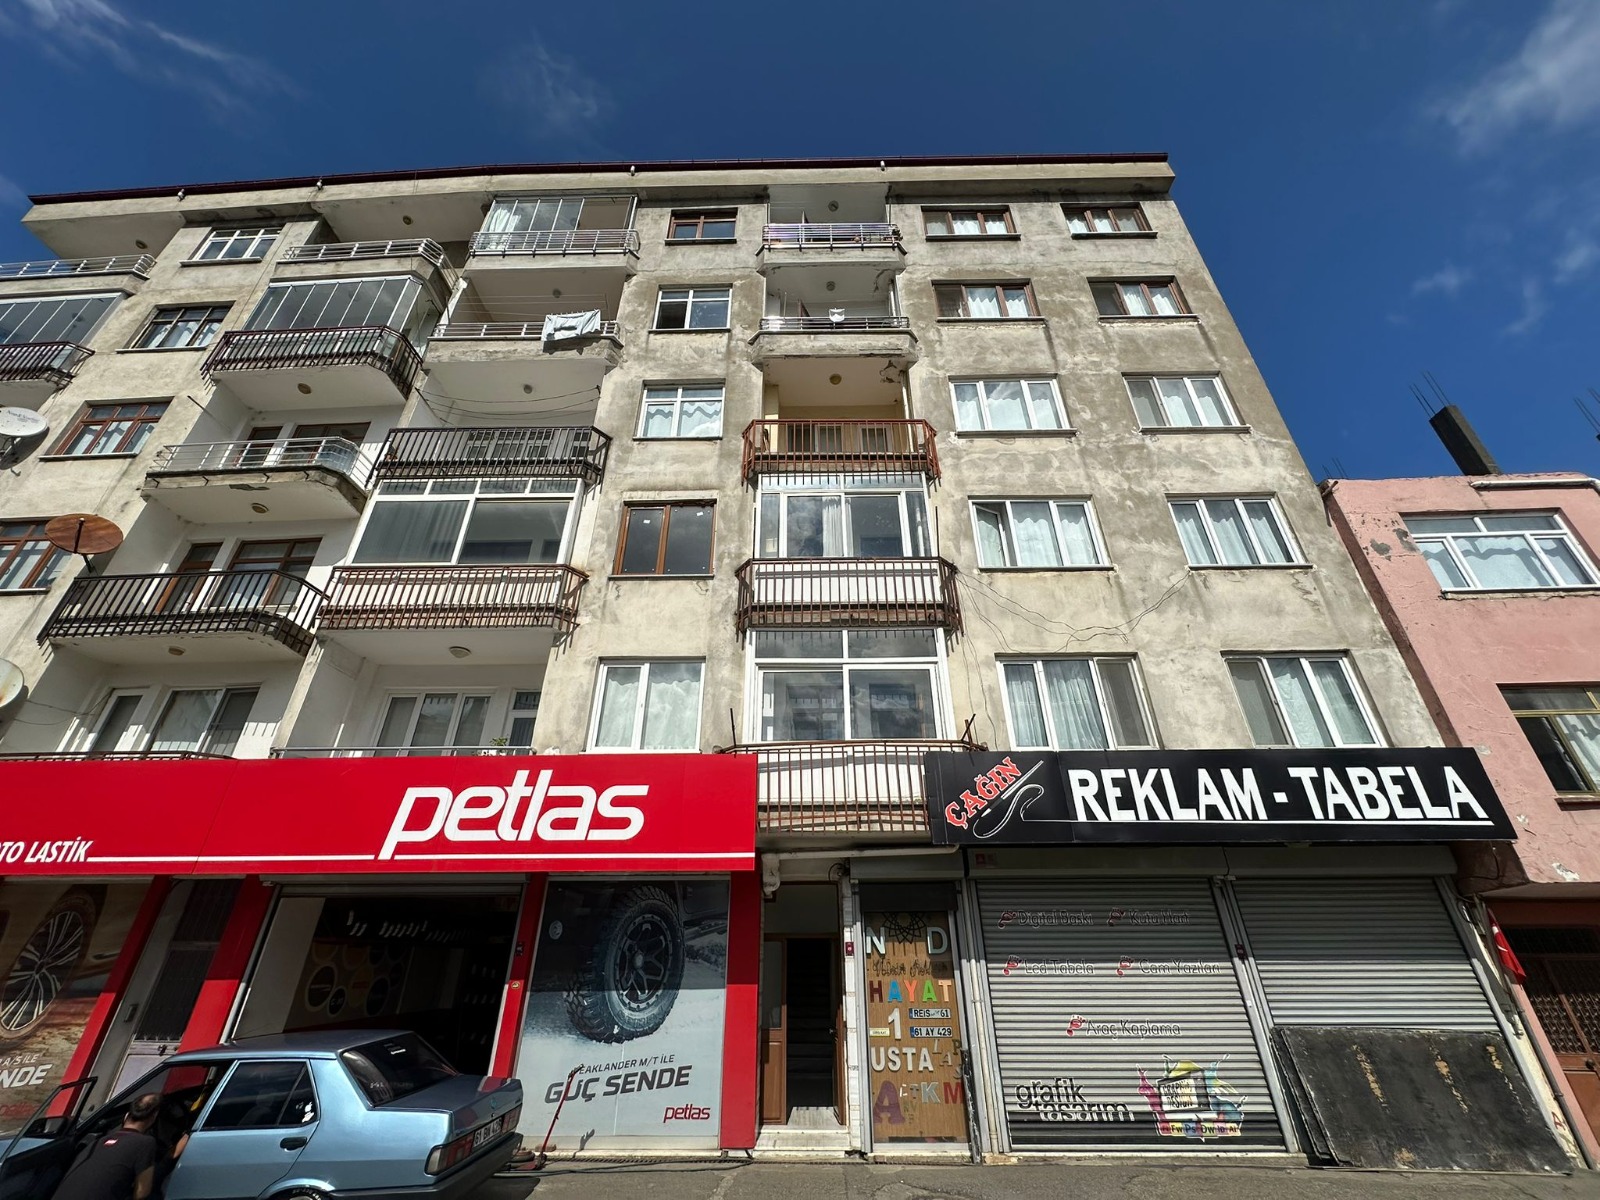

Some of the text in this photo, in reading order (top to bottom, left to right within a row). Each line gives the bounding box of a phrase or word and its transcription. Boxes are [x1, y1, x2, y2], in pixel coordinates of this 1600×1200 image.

[945, 756, 1022, 830] ÇAĞIN
[1067, 767, 1269, 822] REKLAM
[1287, 765, 1490, 820] TABELA
[377, 769, 650, 861] petlas
[0, 835, 94, 863] TO LASTİK
[1024, 958, 1096, 975] Led Tabela
[1138, 959, 1171, 975] Cam
[868, 979, 953, 1004] HAYAT
[940, 1008, 950, 1018] 61
[914, 1027, 952, 1037] 61 AY 429
[1086, 1018, 1182, 1041] Araç Kaplama
[578, 1053, 676, 1075] EAKLANDER M/T İLE
[870, 1045, 935, 1073] USTA
[0, 1063, 54, 1089] NDE
[602, 1064, 693, 1097] SENDE
[1015, 1077, 1087, 1110] grafik
[662, 1103, 711, 1124] petlas
[1030, 1100, 1135, 1122] tasarım
[1185, 1123, 1197, 1134] Ps
